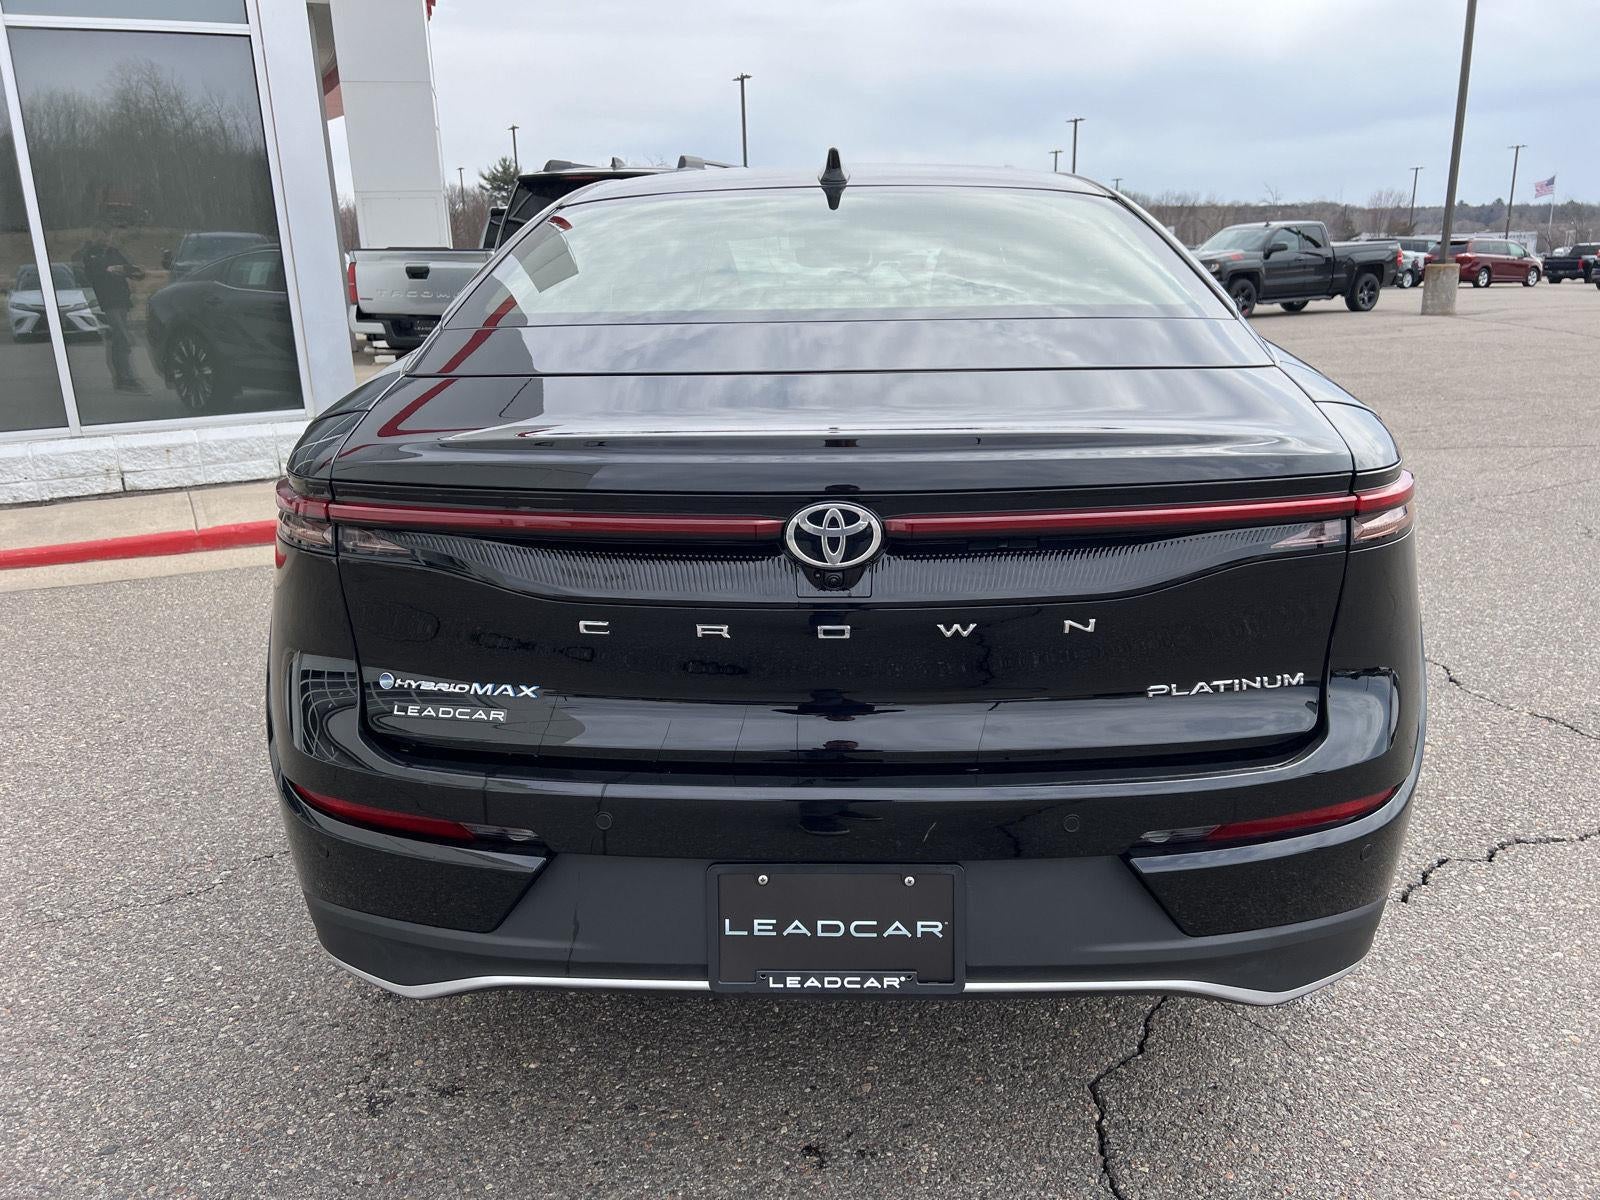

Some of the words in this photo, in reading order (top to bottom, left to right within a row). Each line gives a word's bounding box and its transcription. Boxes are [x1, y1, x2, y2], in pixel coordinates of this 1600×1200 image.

[376, 288, 459, 299] TACOM
[578, 617, 1097, 639] CROWN
[1146, 672, 1305, 698] PLATINUM
[393, 704, 505, 722] LEADCAR
[724, 918, 944, 938] LEADCAR
[769, 976, 900, 989] LEADCAR
